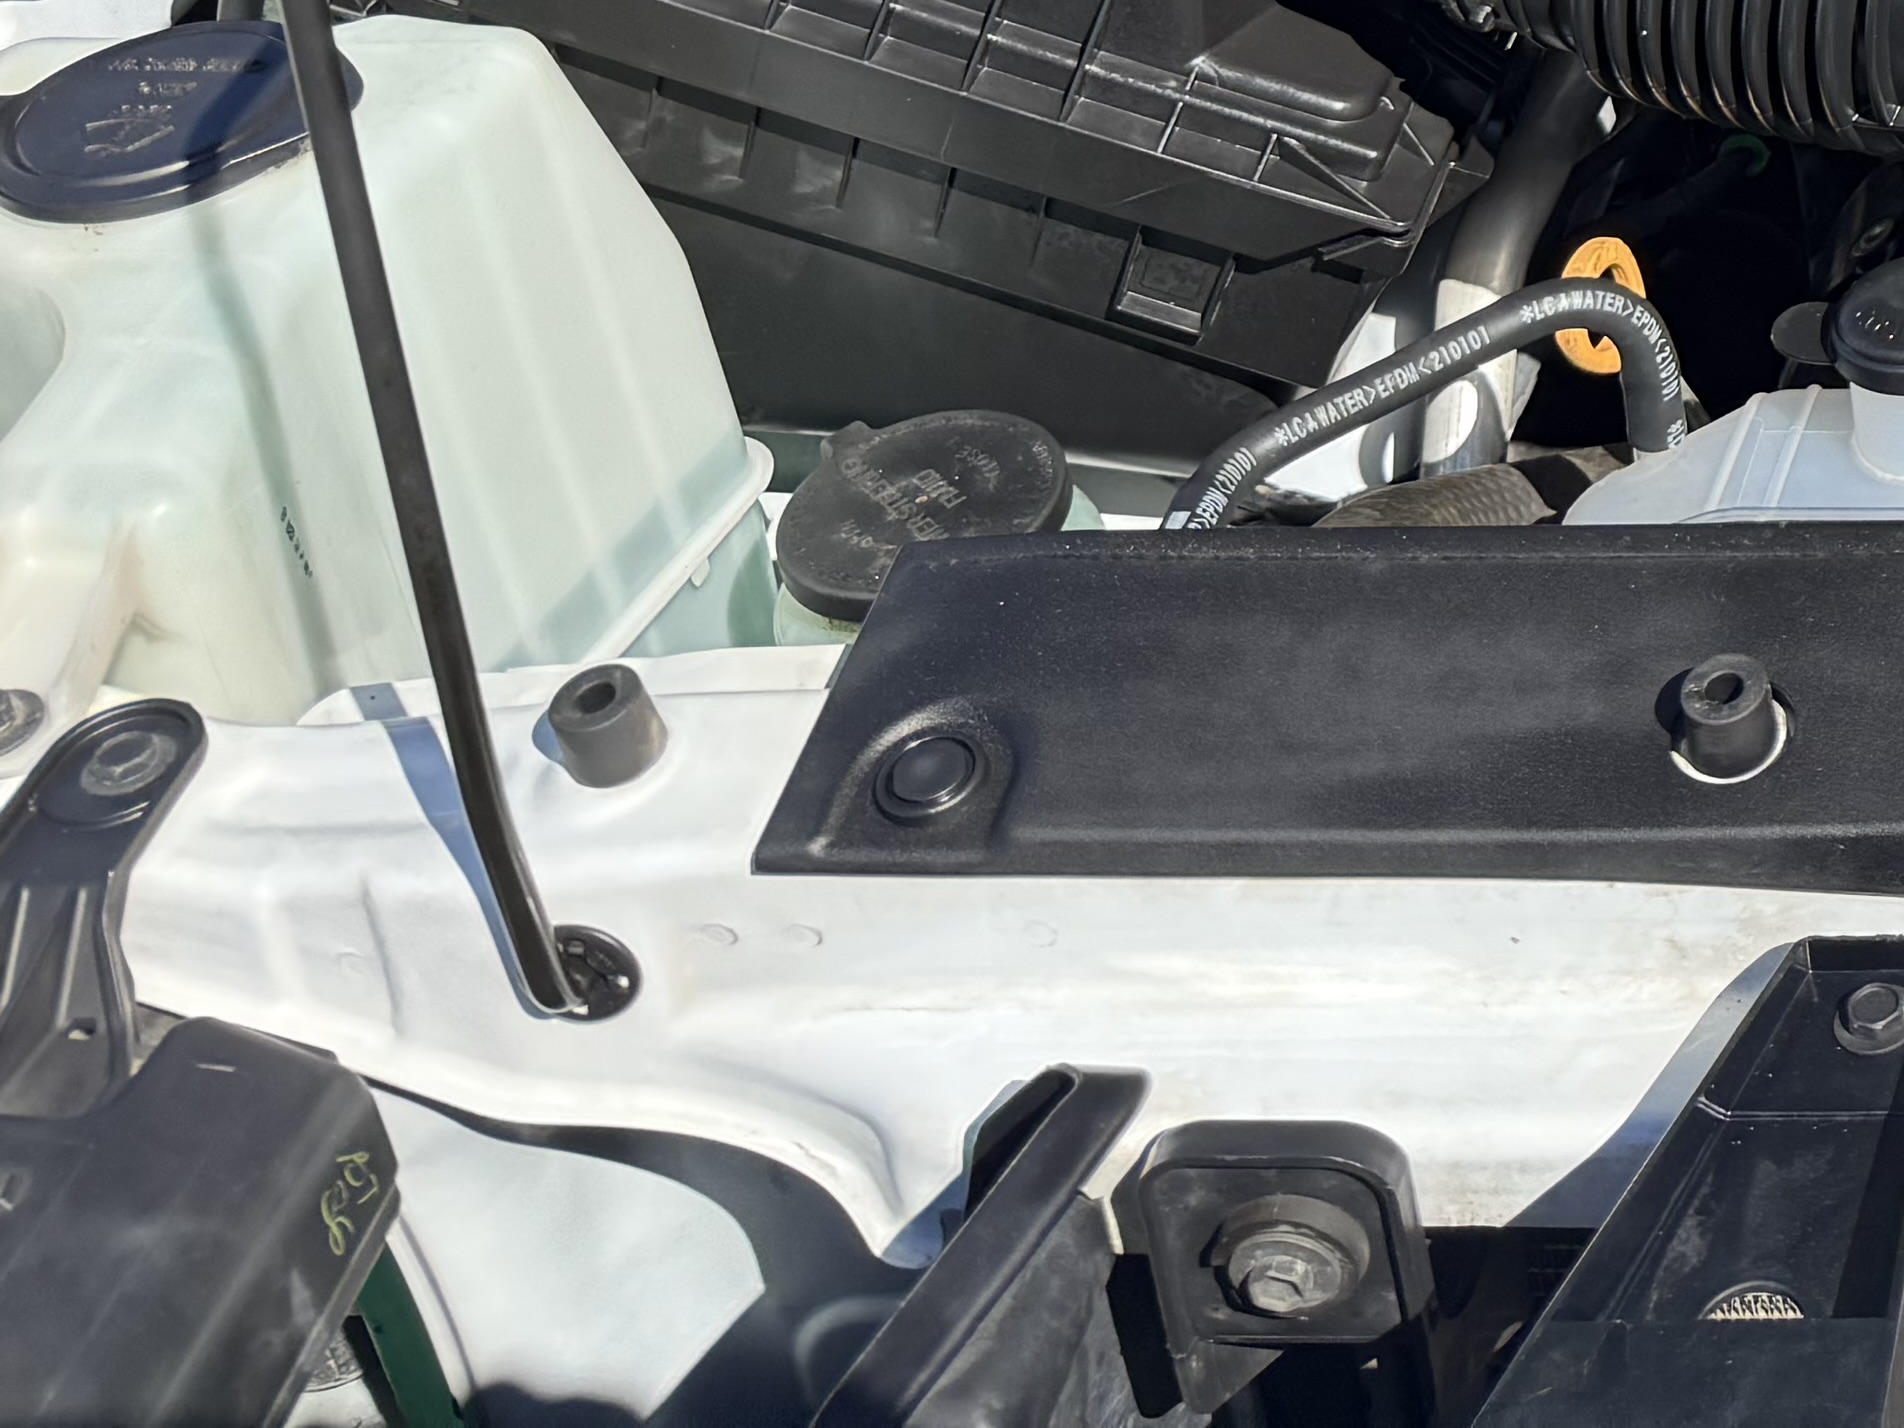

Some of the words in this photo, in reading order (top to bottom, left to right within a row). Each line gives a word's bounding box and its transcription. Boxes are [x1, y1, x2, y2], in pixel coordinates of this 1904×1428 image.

[955, 445, 1001, 478] CLOSE
[841, 457, 918, 523] STEERING
[912, 468, 968, 509] FLUID
